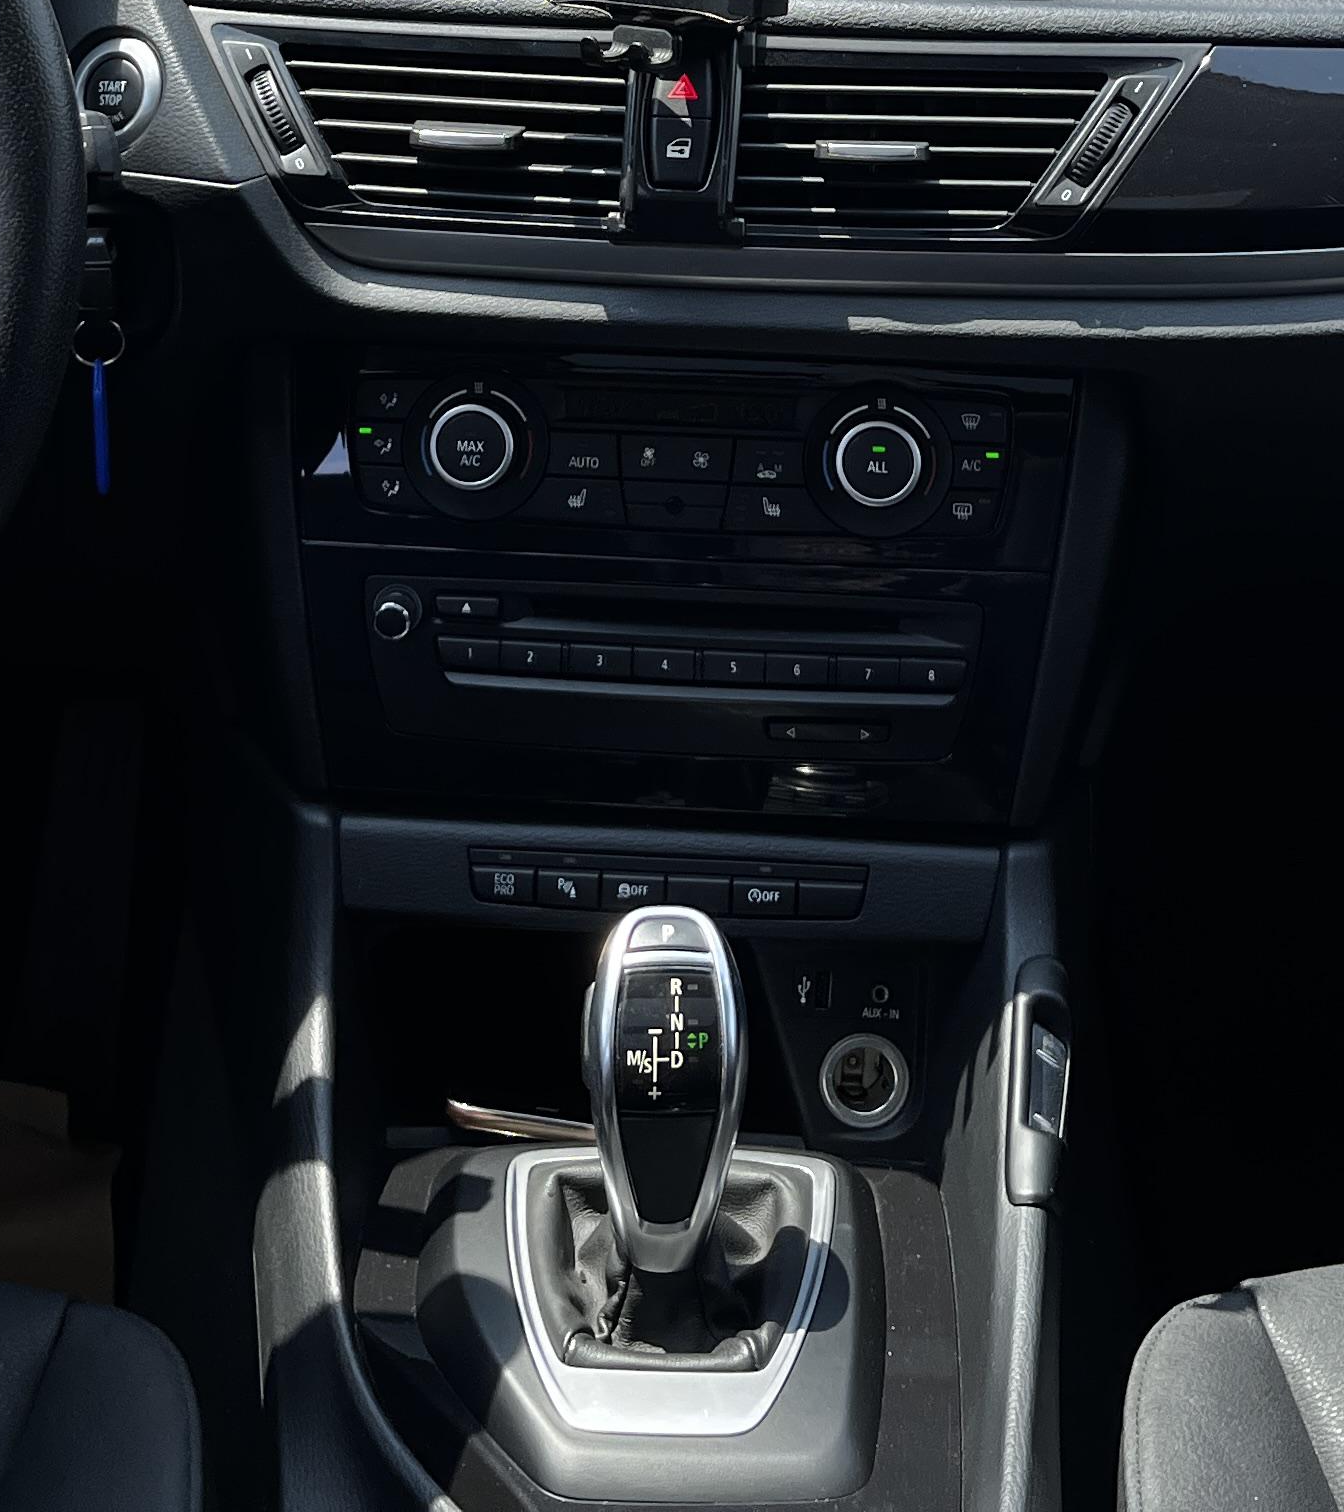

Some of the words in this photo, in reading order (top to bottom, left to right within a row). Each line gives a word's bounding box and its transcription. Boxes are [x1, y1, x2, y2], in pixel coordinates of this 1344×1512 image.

[98, 80, 128, 93] START
[99, 94, 123, 106] STOP
[456, 439, 485, 453] MAX
[459, 454, 482, 468] A/C
[568, 456, 599, 469] AUTO
[640, 457, 656, 468] OFF
[866, 461, 889, 474] ALL
[961, 458, 982, 472] A/C
[468, 647, 473, 660] 1
[526, 650, 534, 663] 2
[596, 654, 603, 667] 3
[661, 659, 669, 671] 4
[730, 661, 737, 673] 5
[793, 663, 801, 676] 6
[864, 668, 872, 680] 7
[927, 669, 935, 682] 8
[494, 873, 515, 885] ECO
[493, 884, 515, 896] PRO
[630, 884, 649, 896] OFF
[762, 890, 781, 903] OFF
[662, 924, 675, 943] P
[670, 978, 683, 996] R
[670, 1013, 684, 1031] N
[698, 1032, 709, 1049] P
[626, 1050, 653, 1074] M/S
[670, 1050, 684, 1069] D
